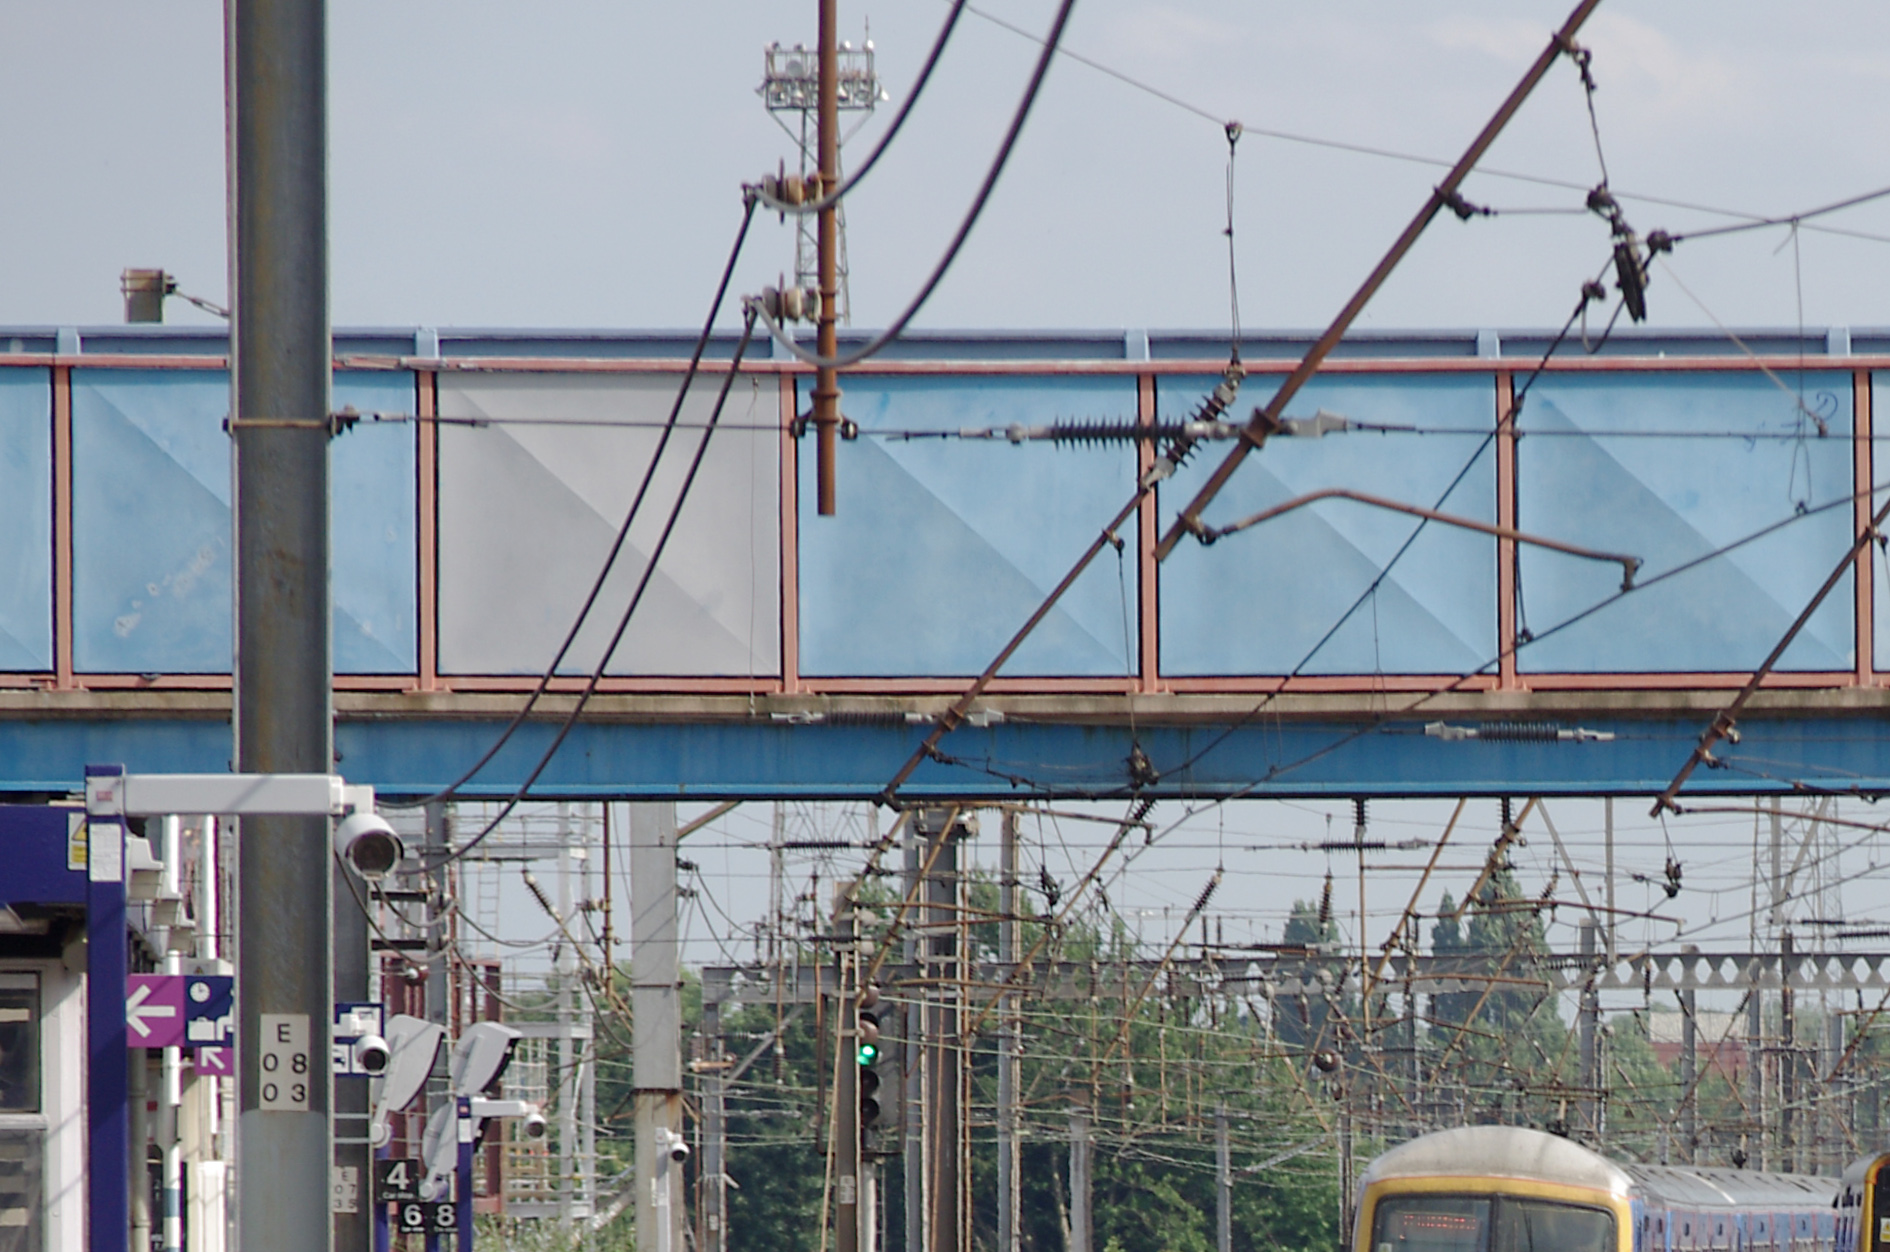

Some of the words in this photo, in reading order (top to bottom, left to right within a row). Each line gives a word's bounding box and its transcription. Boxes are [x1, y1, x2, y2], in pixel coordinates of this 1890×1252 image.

[277, 1023, 291, 1043] E
[387, 1162, 409, 1190] 4
[404, 1204, 422, 1226] 6
[437, 1204, 455, 1227] 8
